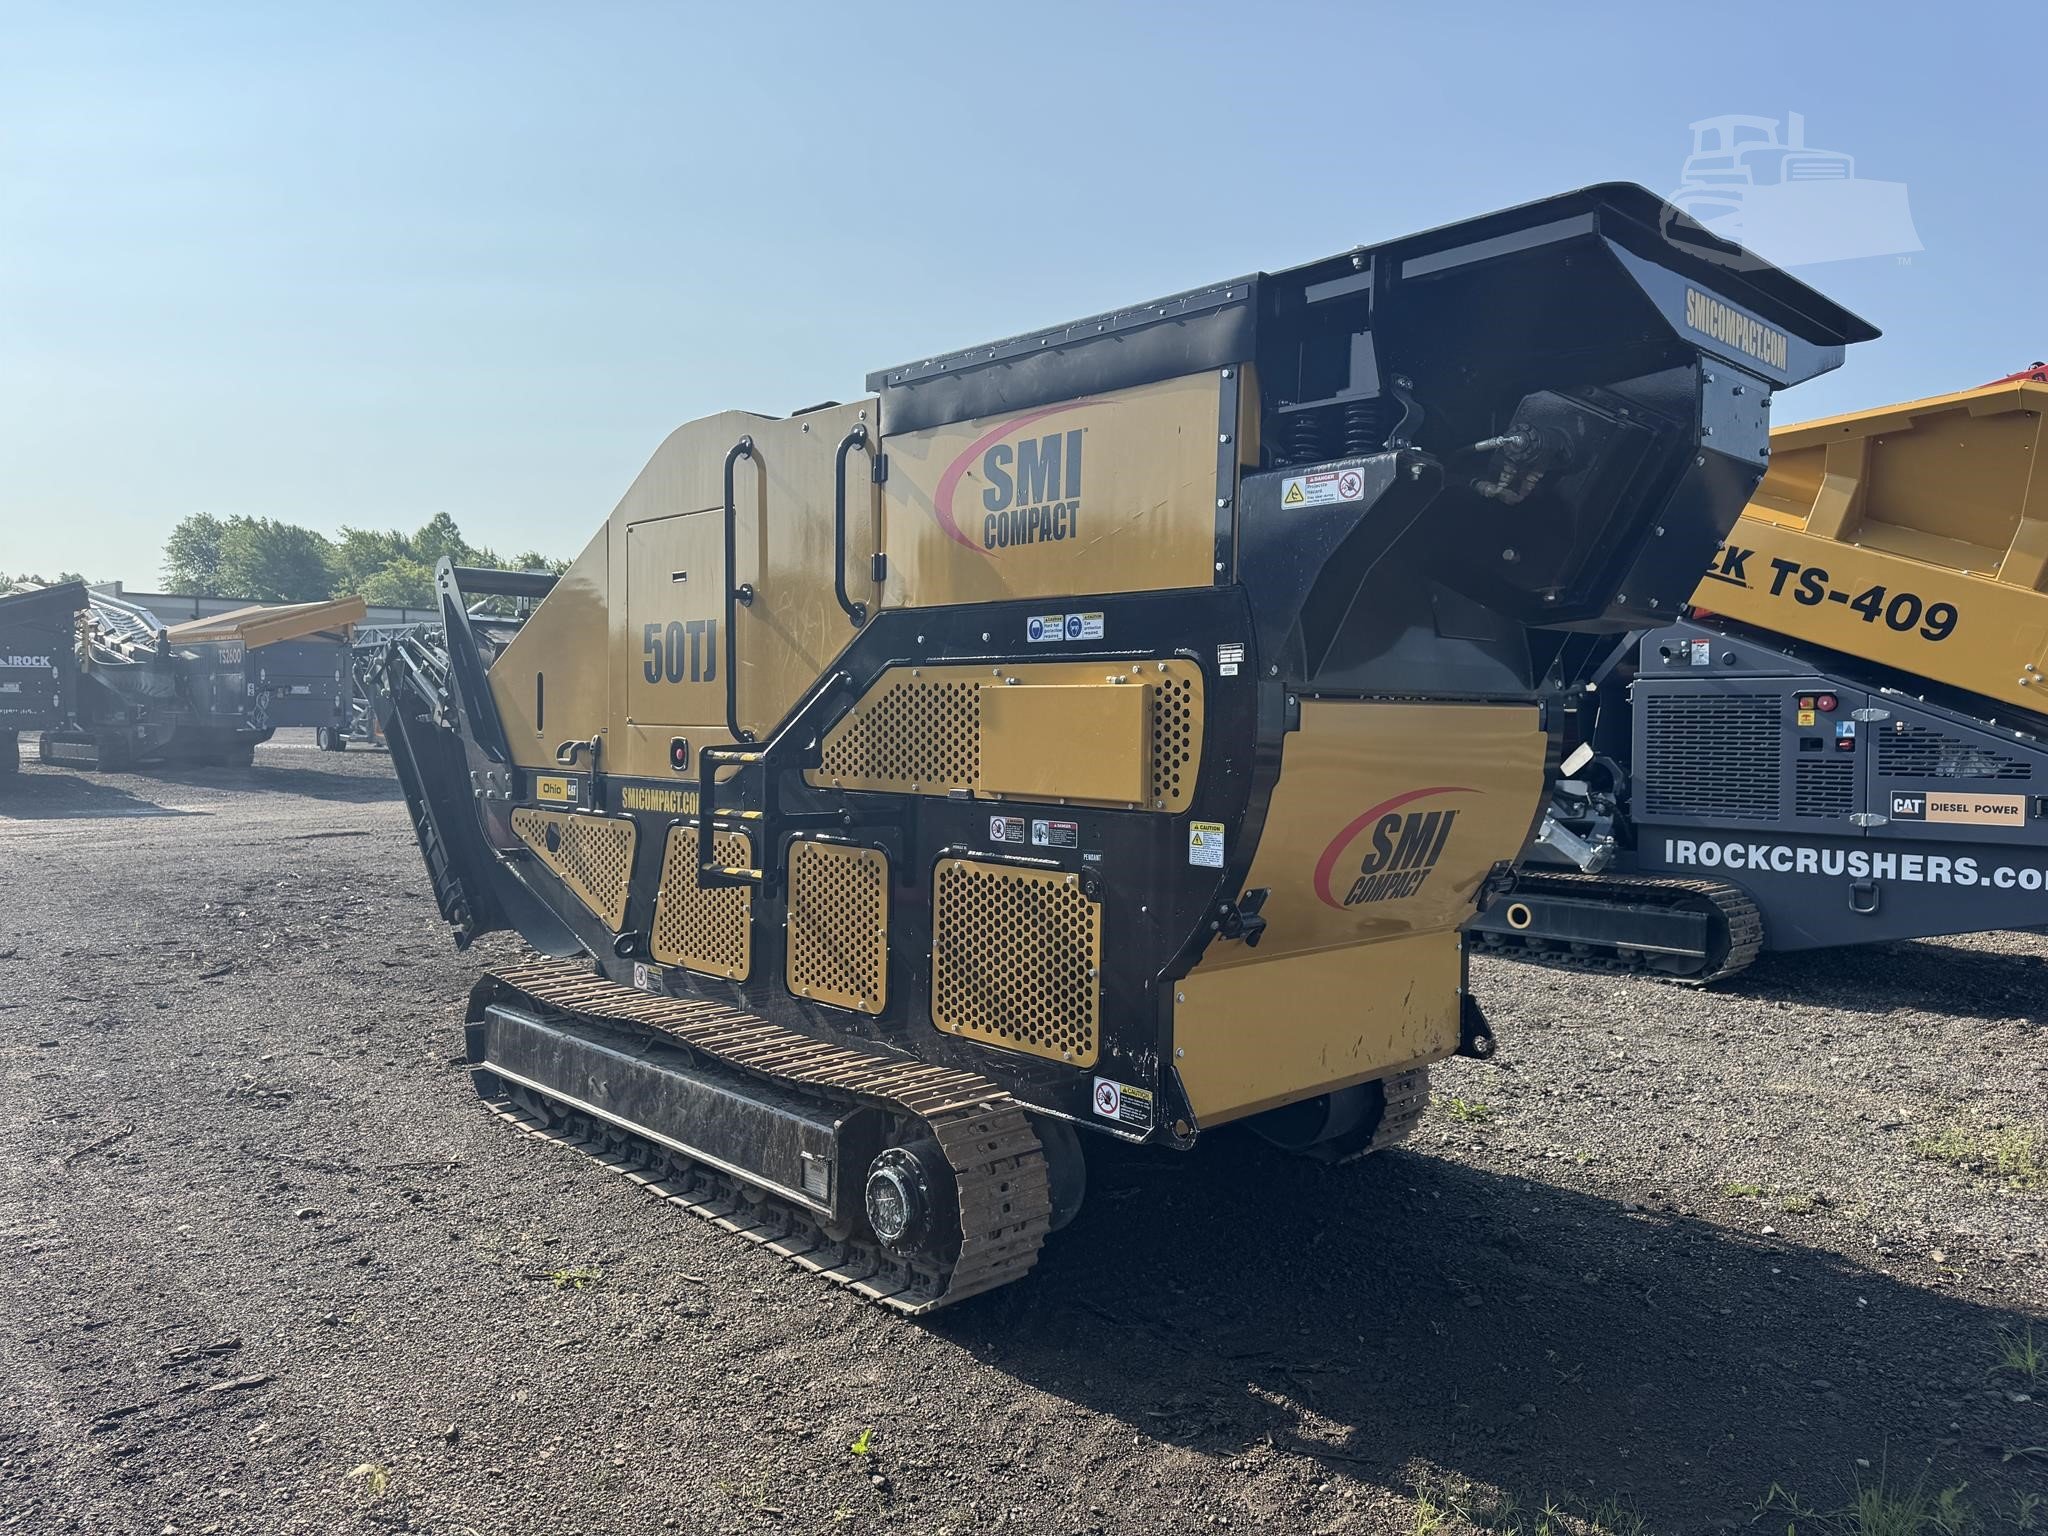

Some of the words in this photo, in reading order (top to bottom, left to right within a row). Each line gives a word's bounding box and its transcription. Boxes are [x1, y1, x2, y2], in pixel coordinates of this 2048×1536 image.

[1686, 287, 1788, 372] SMICOMPACT.COM
[982, 428, 1083, 512] SMI
[984, 500, 1081, 550] COMPACT
[1769, 557, 1959, 642] TS-409
[8, 655, 51, 666] IROCK
[643, 618, 717, 685] 50TJ
[543, 783, 562, 795] Ohio
[1893, 798, 1925, 814] CAT
[1930, 802, 1970, 814] DIESEL
[1974, 804, 2020, 816] POWER
[1360, 809, 1457, 875] SMI
[1665, 839, 2048, 891] IROCKCRUSHERS.co
[1343, 868, 1433, 907] COMPACT
